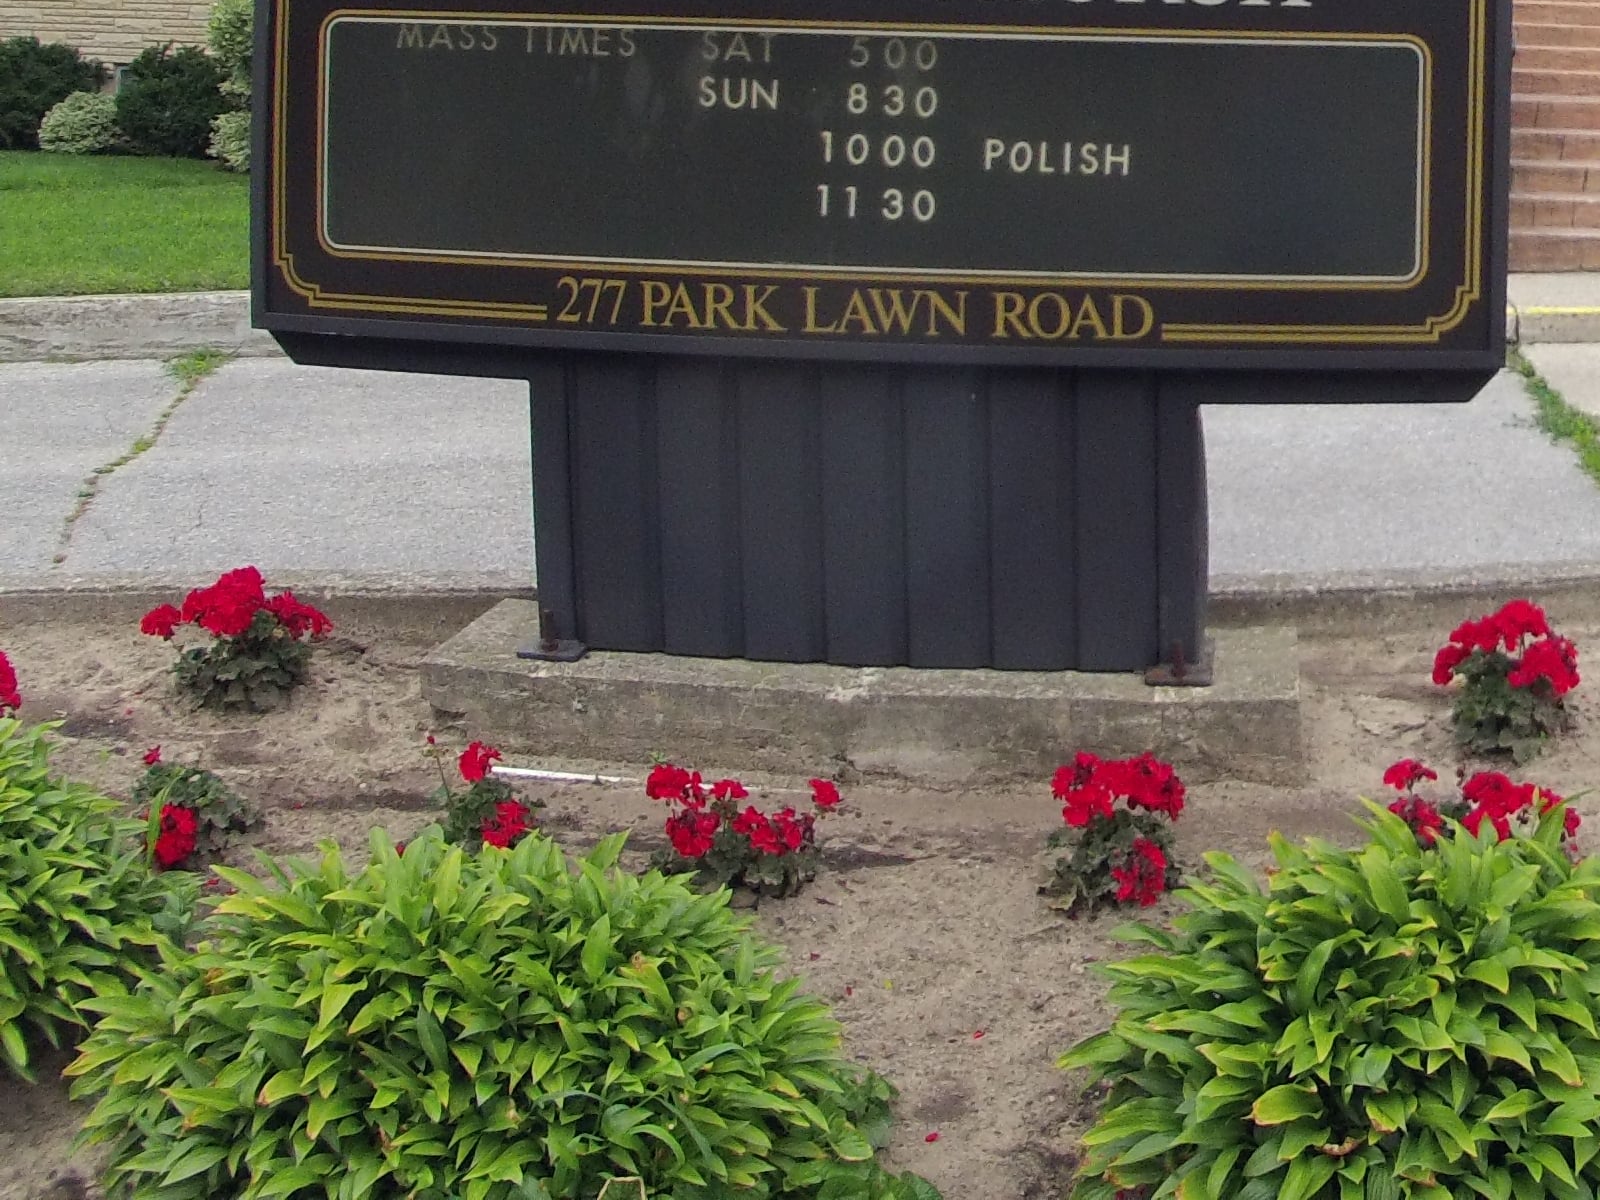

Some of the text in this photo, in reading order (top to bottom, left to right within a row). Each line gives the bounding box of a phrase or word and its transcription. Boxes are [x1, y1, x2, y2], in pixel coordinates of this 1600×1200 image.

[396, 23, 498, 51] MASS
[523, 25, 637, 58] TIMES
[700, 31, 777, 64] SAT
[699, 75, 779, 111] SUN
[984, 138, 1131, 177] POLISH
[556, 276, 1155, 341] 277 PARK LAWN ROAD
